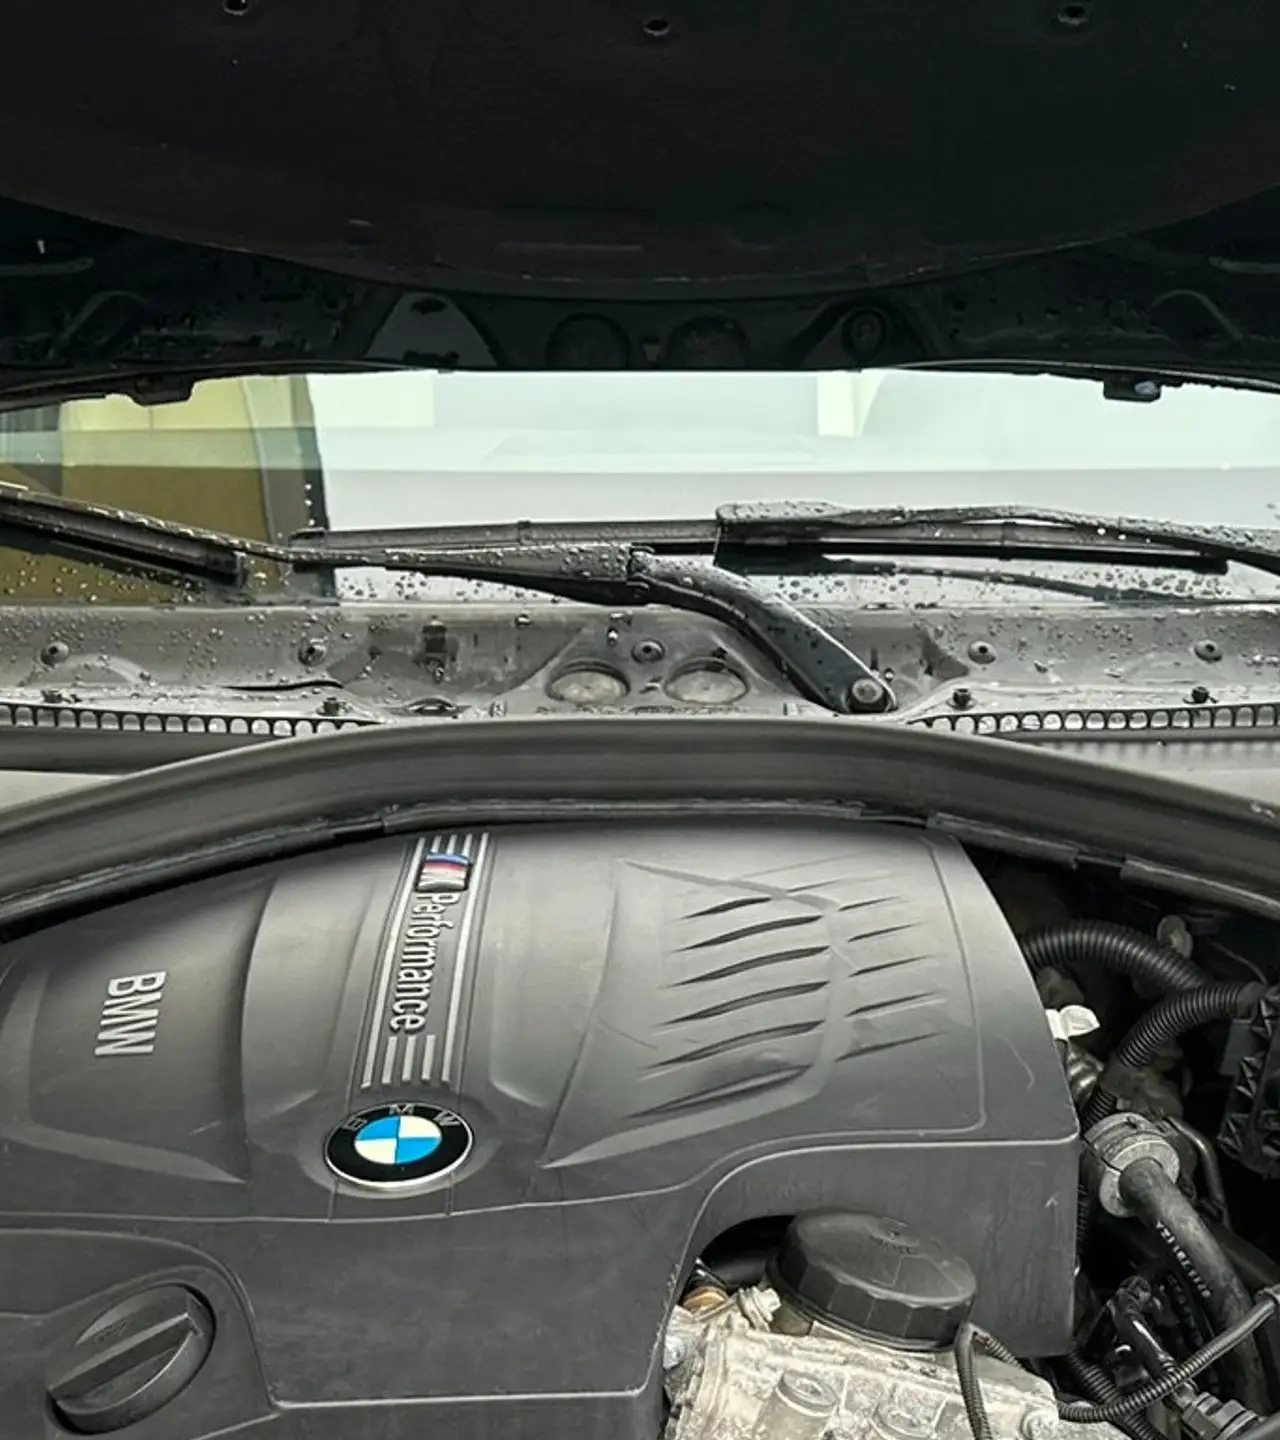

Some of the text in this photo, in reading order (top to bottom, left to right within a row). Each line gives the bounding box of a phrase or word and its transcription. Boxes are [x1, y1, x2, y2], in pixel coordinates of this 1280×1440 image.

[389, 893, 460, 1033] Performance
[94, 970, 167, 1056] BMW
[342, 1103, 463, 1132] BMW
